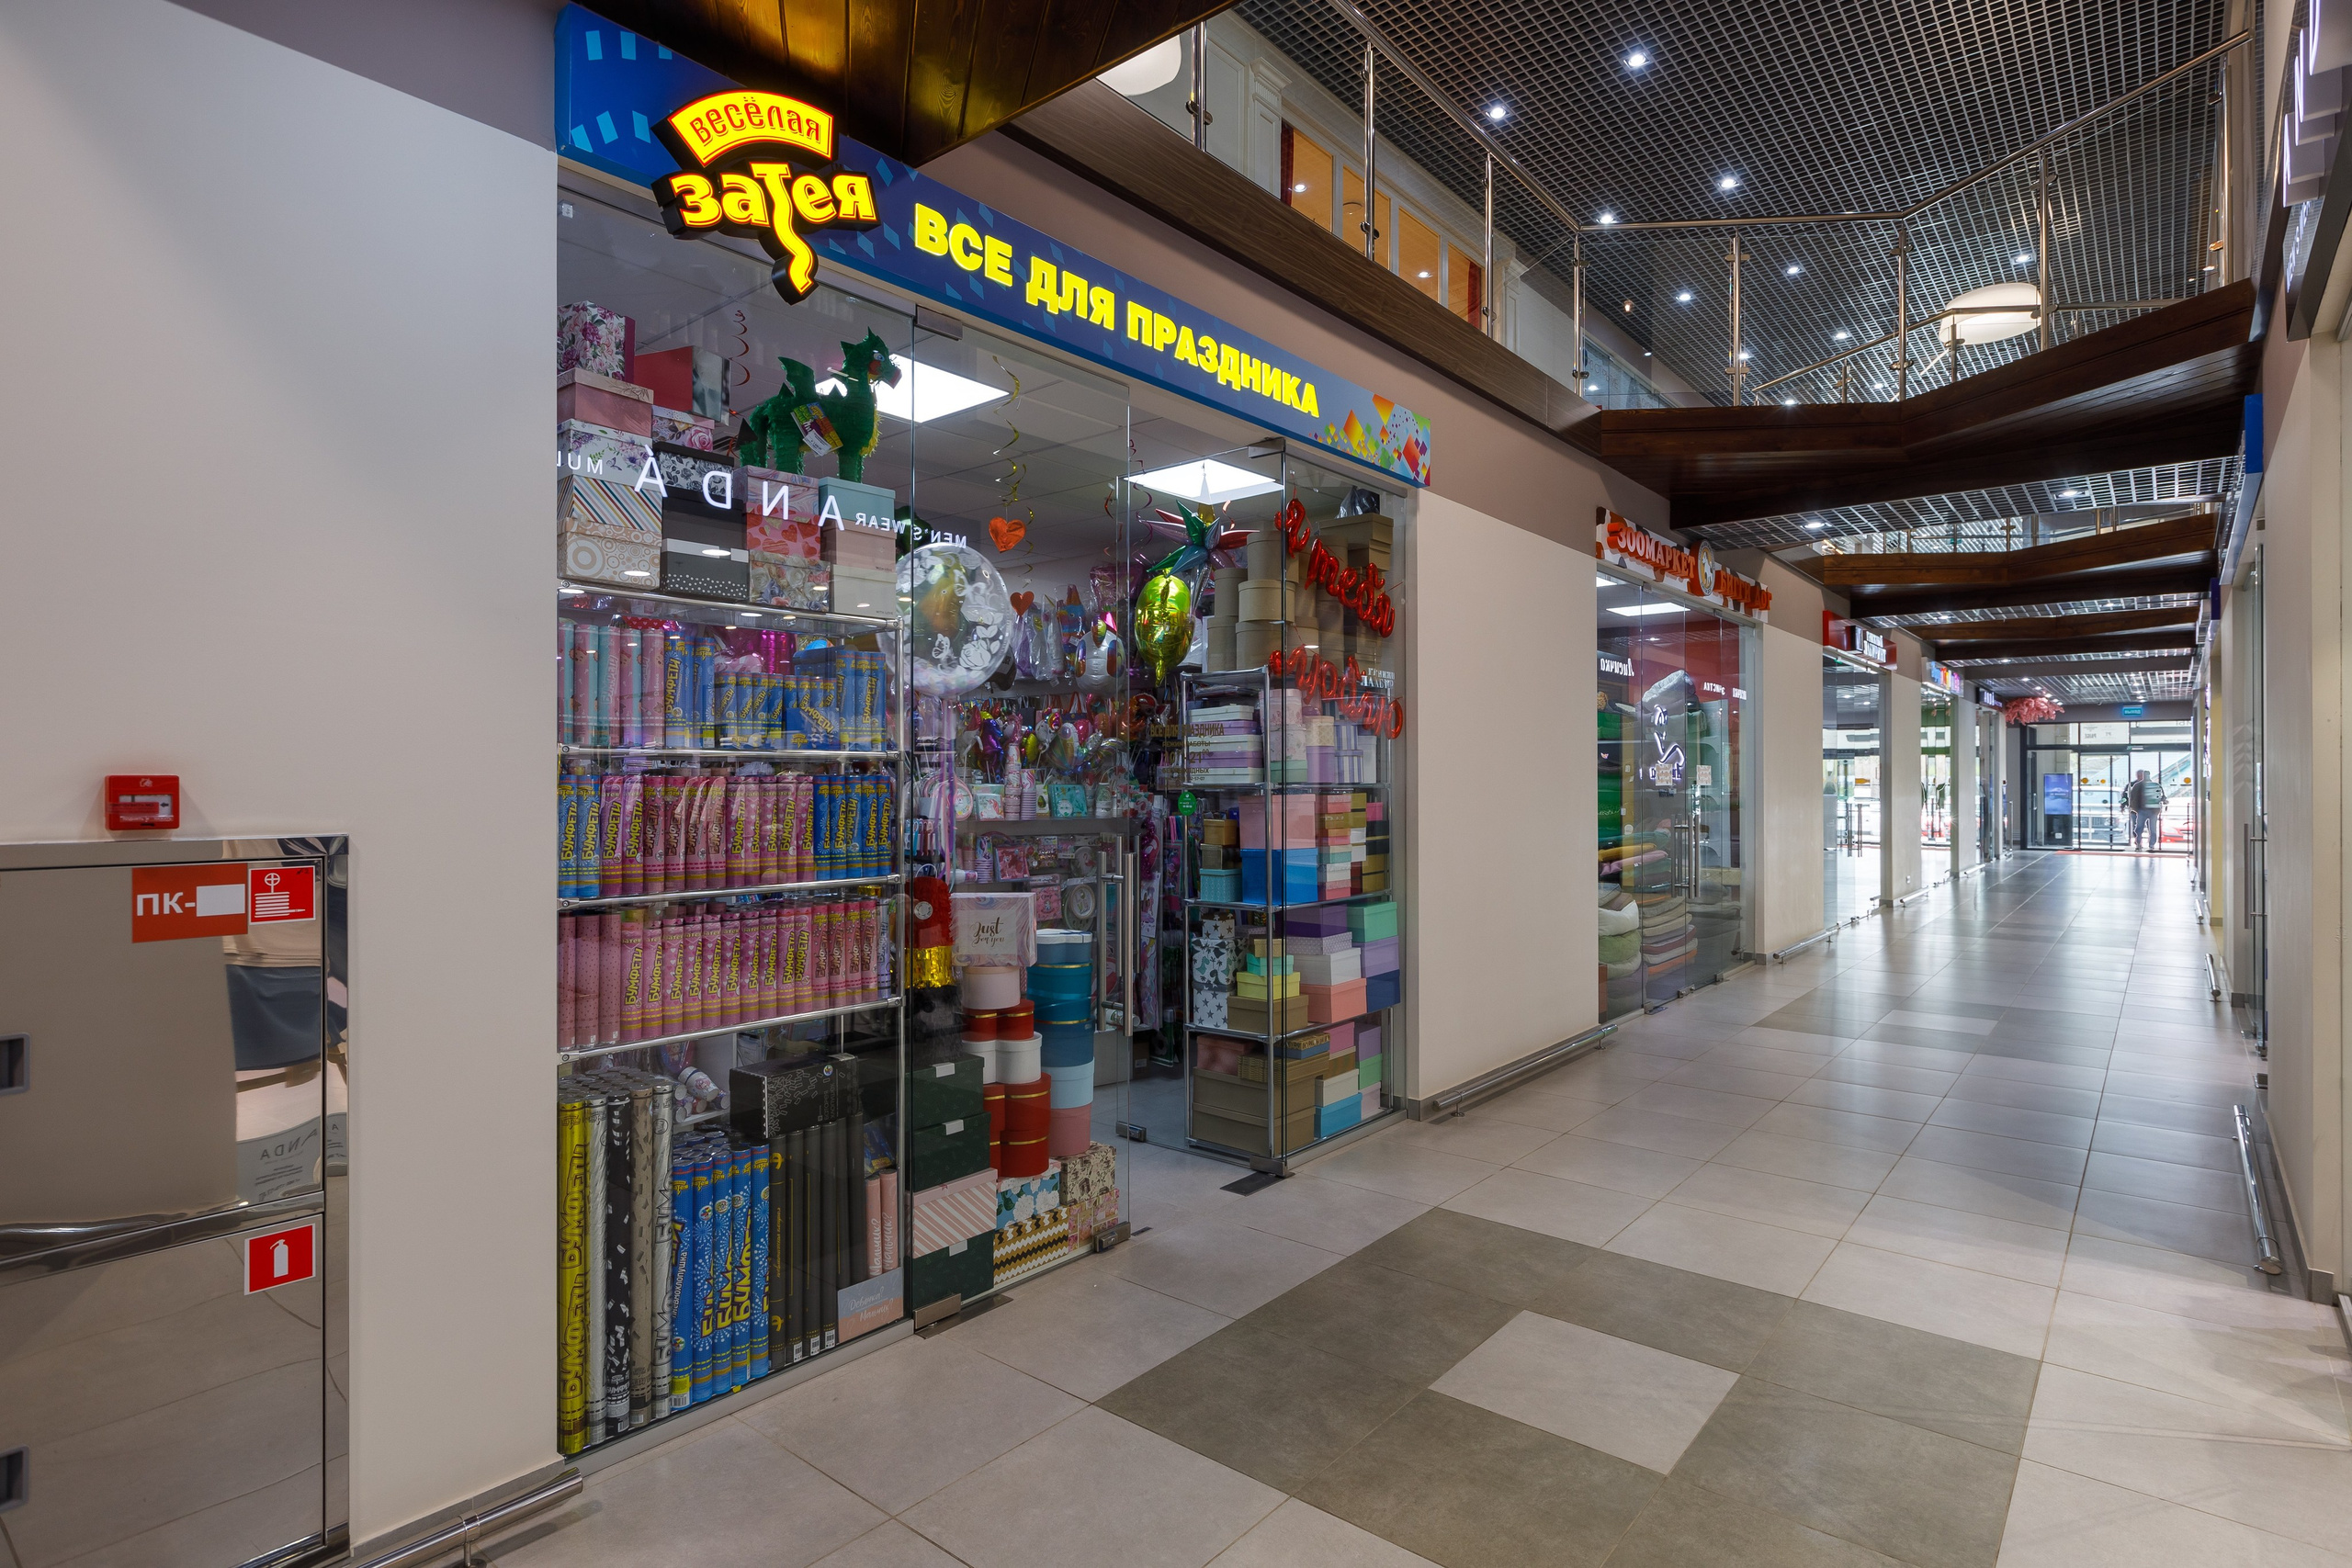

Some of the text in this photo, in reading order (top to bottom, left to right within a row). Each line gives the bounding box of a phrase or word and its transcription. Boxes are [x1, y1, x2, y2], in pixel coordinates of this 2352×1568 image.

[915, 203, 1319, 417] ВСЕ ДЛЯ ПРАЗДНИКА
[1610, 524, 1695, 578] ЗООМАРКЕТ
[862, 676, 878, 724] БУМФЕТИ
[561, 802, 577, 861] БУМФЕТИ
[582, 802, 600, 861] БУМФЕТИ
[603, 802, 621, 860] БУМФЕТИ
[626, 801, 643, 858] БУМФЕТИ
[780, 798, 796, 852] БУМФЕТИ
[137, 891, 196, 916] ПК-
[970, 917, 1003, 938] Just
[626, 947, 642, 1005] БУМФЕТИ
